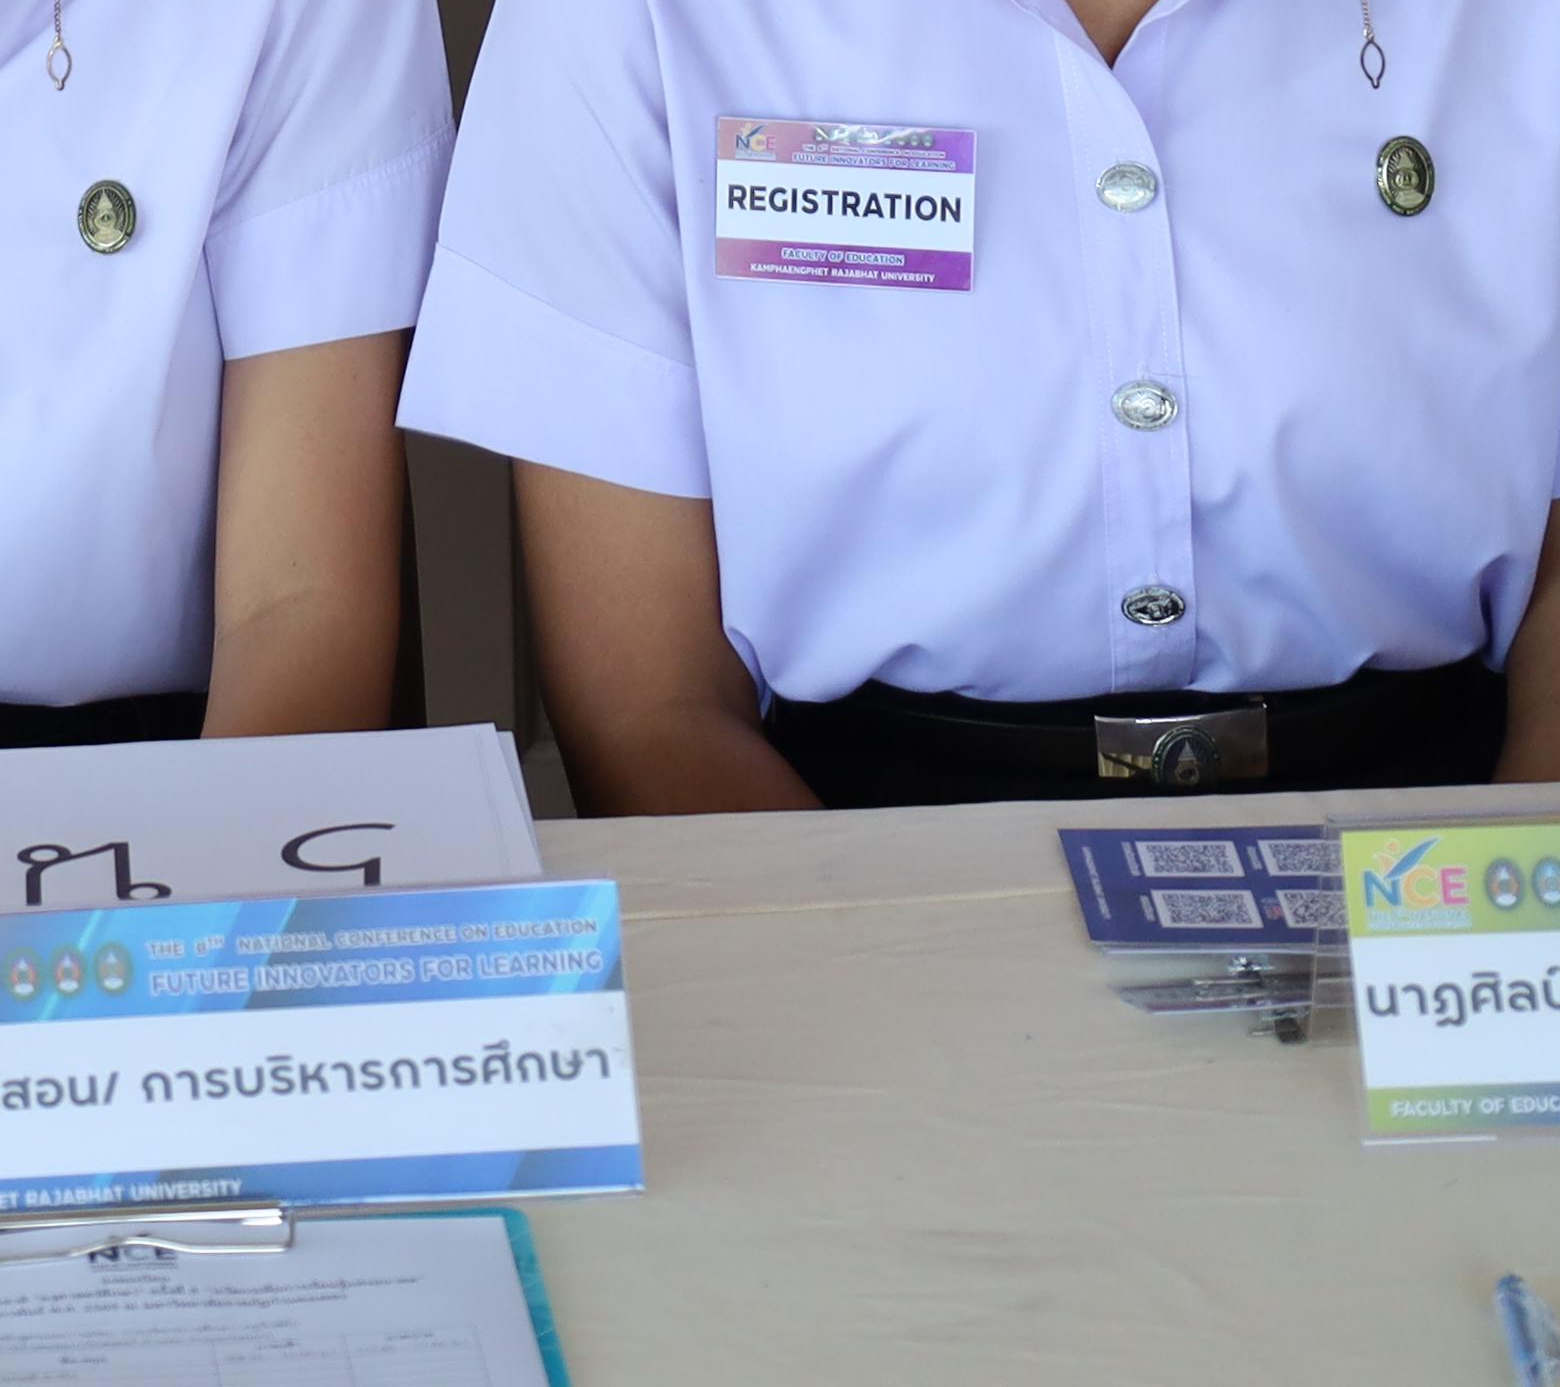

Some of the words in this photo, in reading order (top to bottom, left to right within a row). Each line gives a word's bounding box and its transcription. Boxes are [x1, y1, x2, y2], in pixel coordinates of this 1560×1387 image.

[727, 184, 962, 224] REGISTRATION
[781, 247, 828, 262] FACULTY
[828, 250, 845, 263] OF
[845, 251, 906, 267] EDUCATION
[881, 271, 936, 284] UNIVERSITY
[1364, 866, 1472, 908] NCE
[147, 940, 183, 959] THE
[237, 931, 332, 954] NATIONAL
[335, 925, 459, 949] CONFERENCE
[462, 924, 489, 943] ON
[494, 919, 598, 940] EDUCATION
[151, 967, 249, 996] FUTURE
[256, 957, 414, 992] INNOVATORS
[421, 954, 472, 982] FOR
[478, 950, 602, 979] LEARNING
[141, 1039, 611, 1104] การบริหารการศึกษา
[1390, 1099, 1473, 1119] FACULTY
[1479, 1097, 1506, 1115] OF
[25, 1188, 124, 1210] RAJABHAT
[131, 1178, 242, 1203] UNIVERSITY
